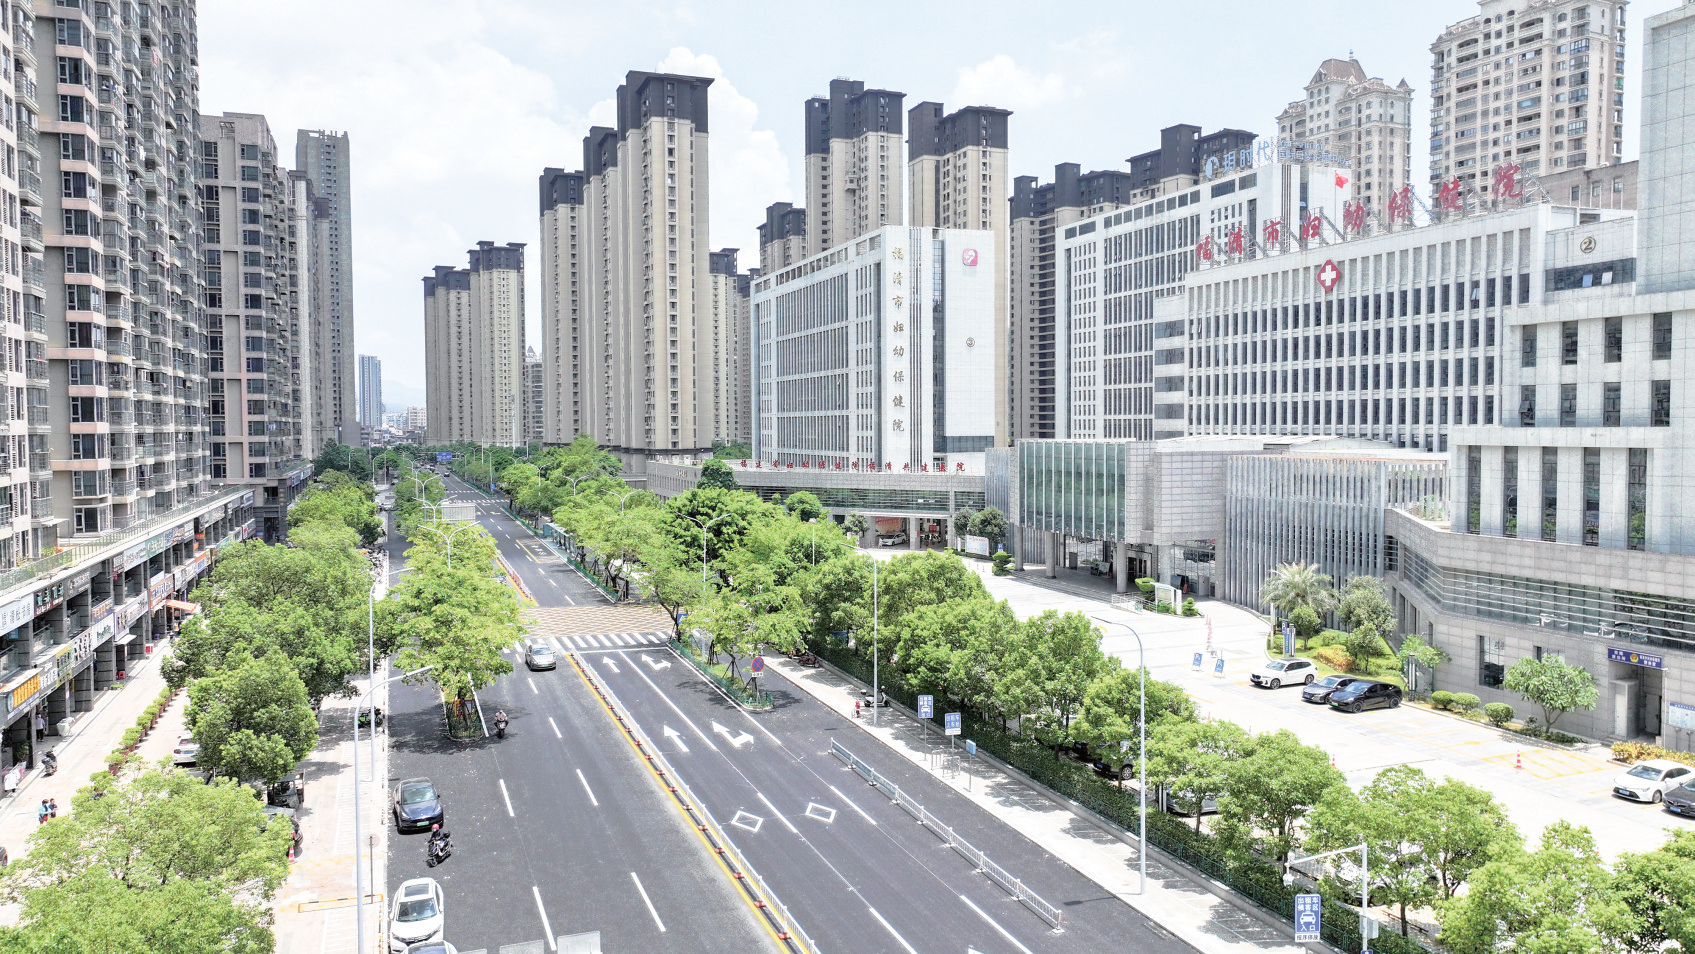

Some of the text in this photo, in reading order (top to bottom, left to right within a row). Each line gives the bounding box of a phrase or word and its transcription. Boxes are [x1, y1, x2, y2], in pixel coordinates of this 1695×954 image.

[1196, 161, 1524, 262] 福清市妇幼保健院
[892, 247, 905, 432] 福清市妇幼保健院
